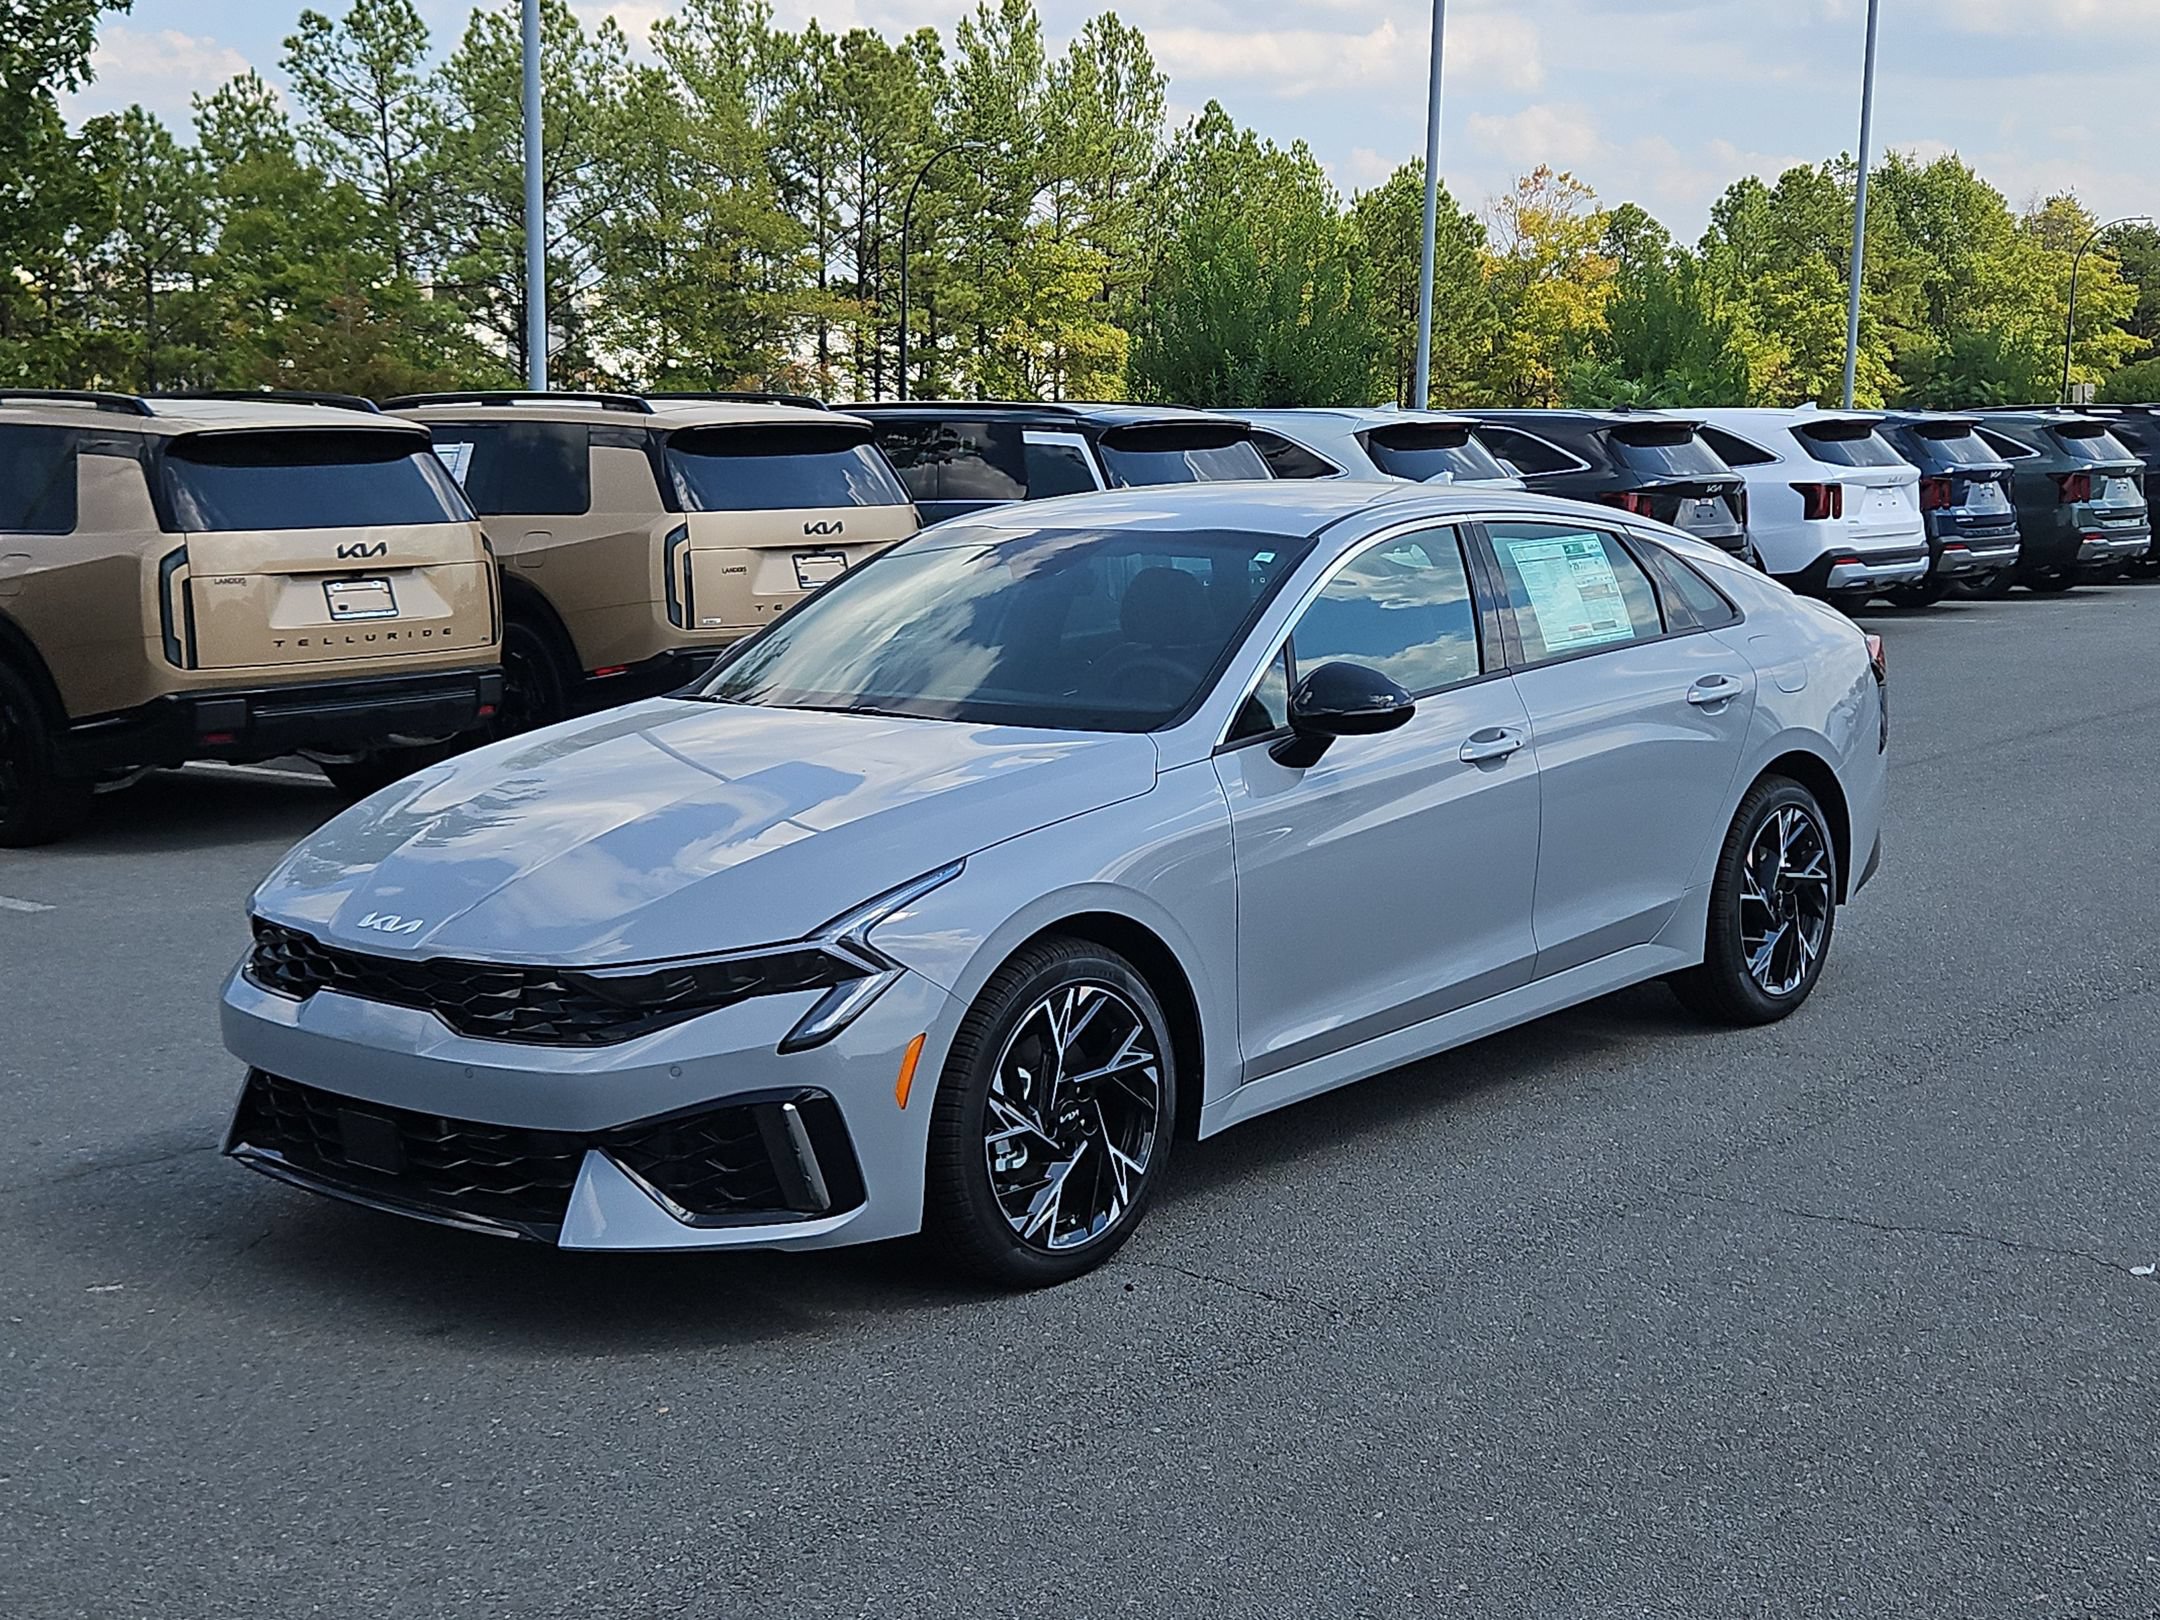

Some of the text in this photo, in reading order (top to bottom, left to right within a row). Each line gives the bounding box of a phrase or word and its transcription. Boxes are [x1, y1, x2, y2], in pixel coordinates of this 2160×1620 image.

[803, 521, 844, 535] KIA
[336, 542, 388, 559] KIA
[273, 628, 452, 647] TELLURIDE
[357, 911, 423, 935] KIA
